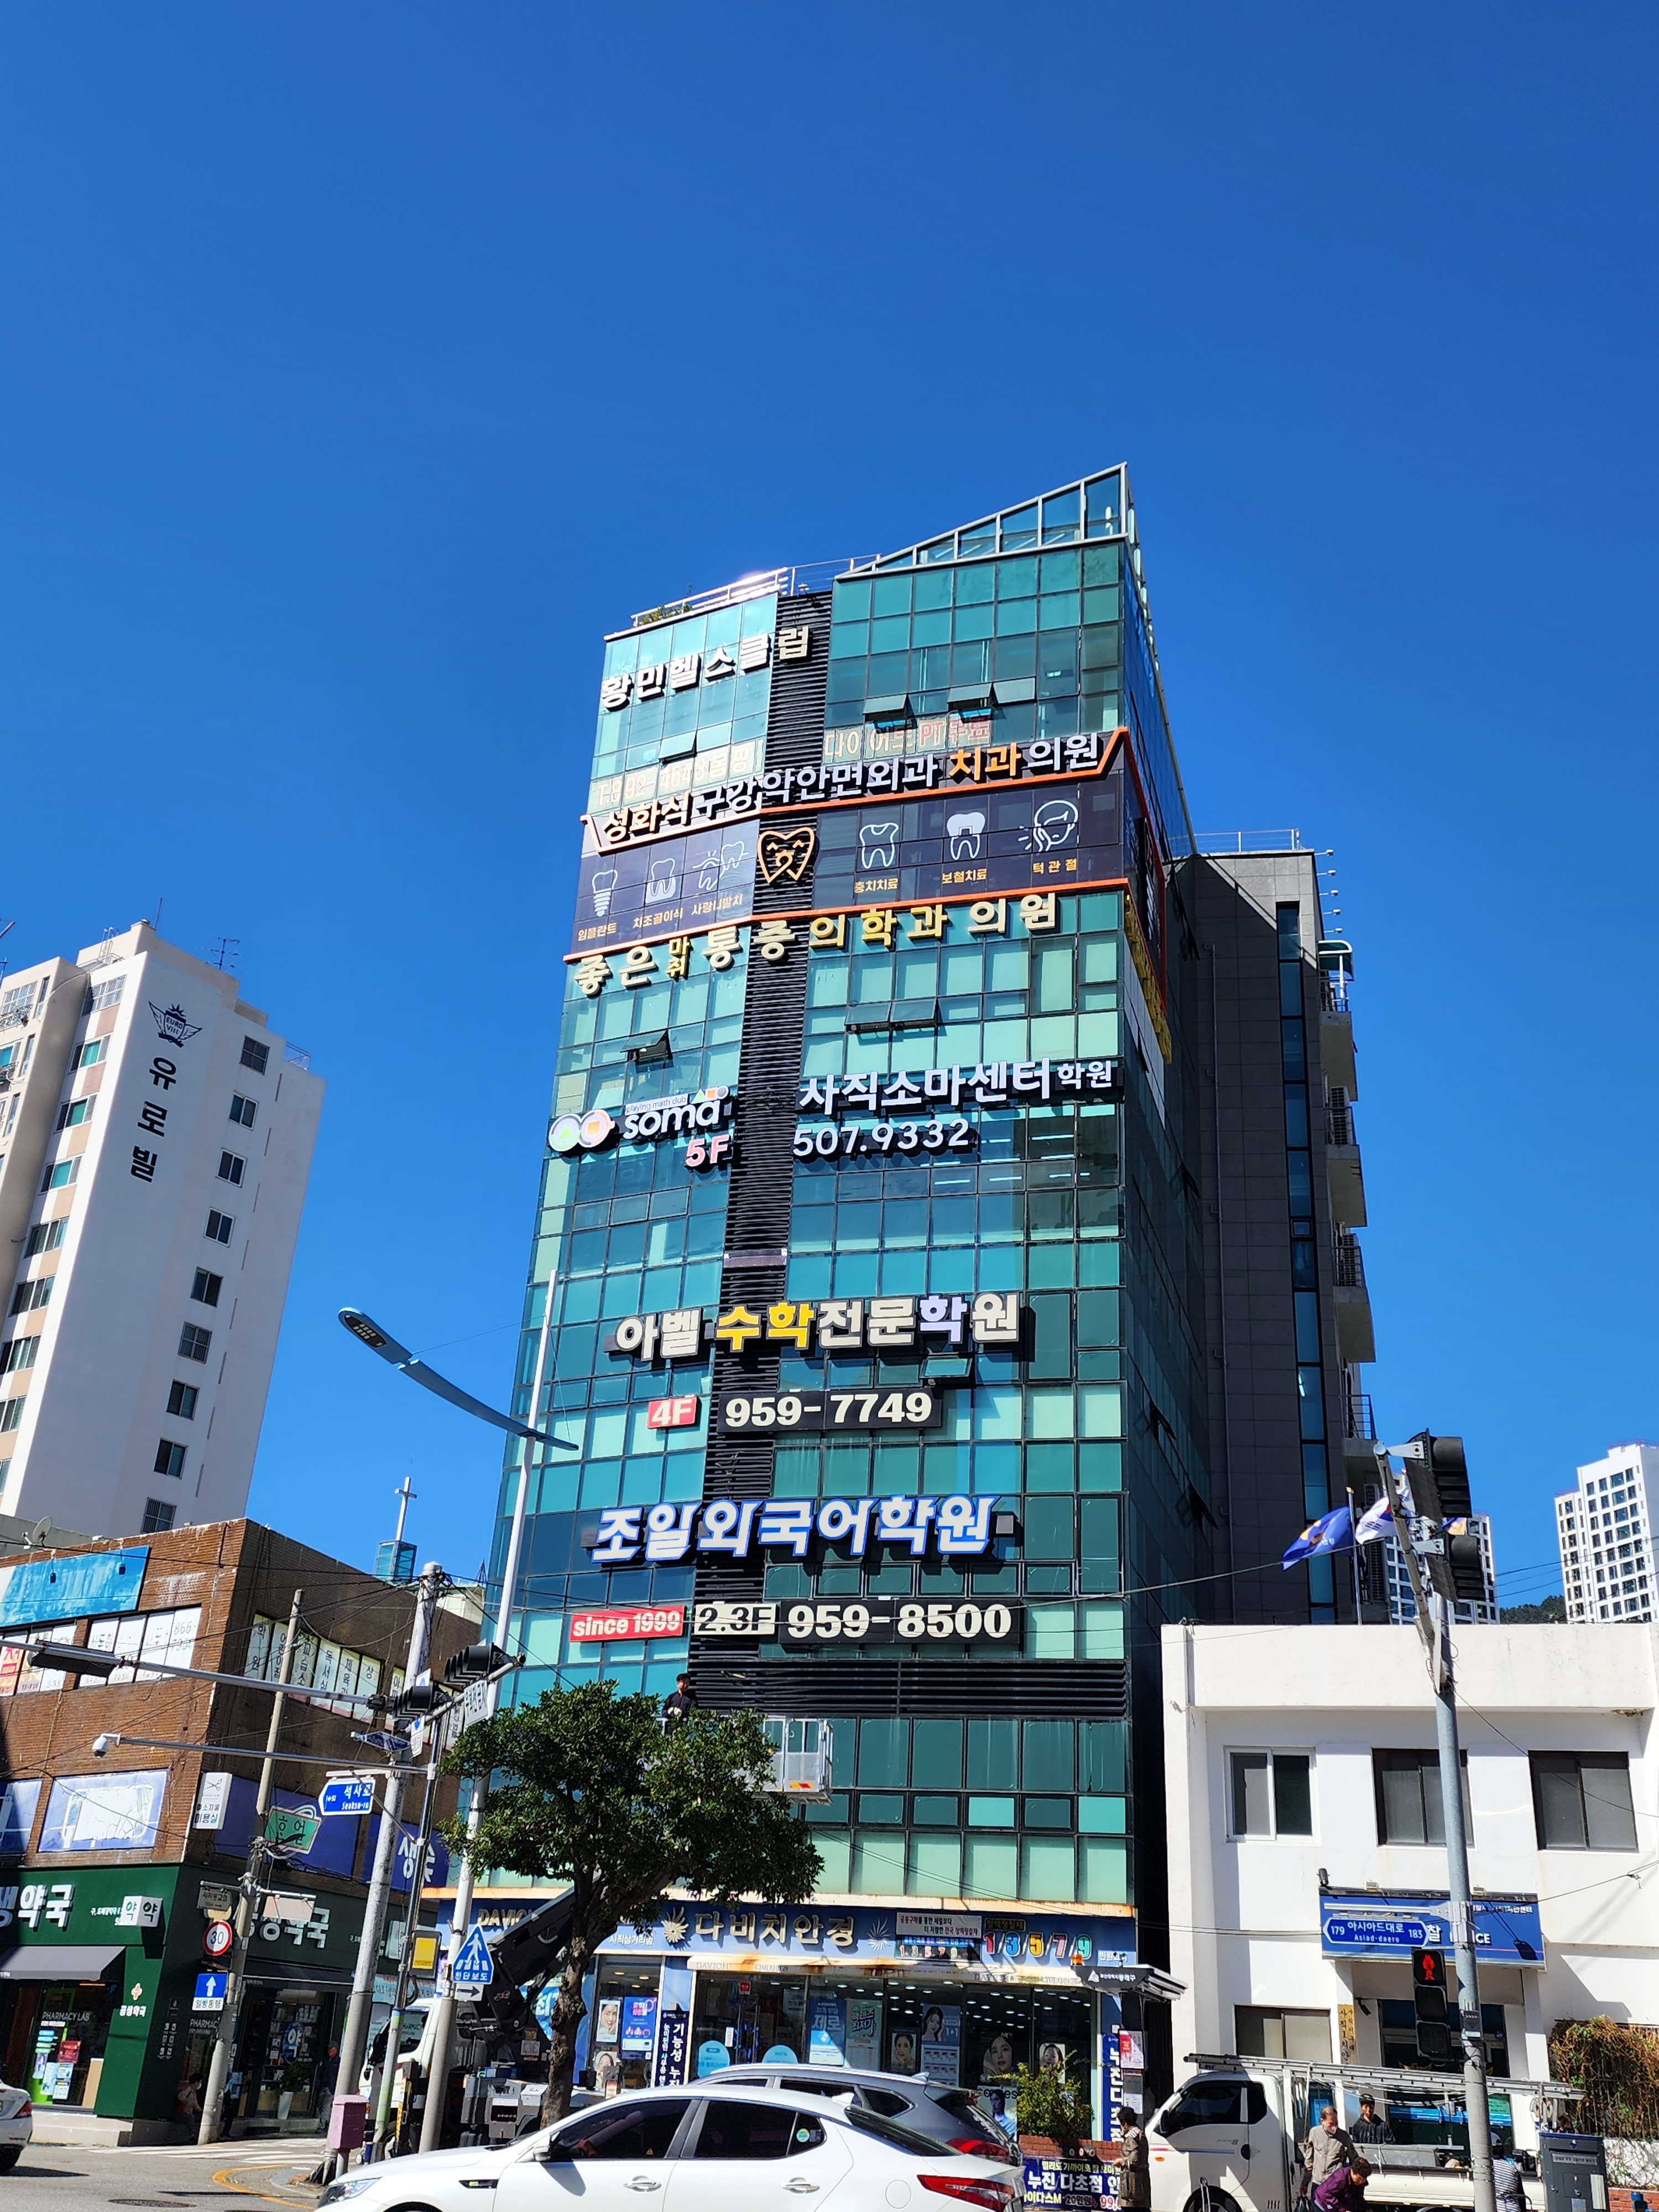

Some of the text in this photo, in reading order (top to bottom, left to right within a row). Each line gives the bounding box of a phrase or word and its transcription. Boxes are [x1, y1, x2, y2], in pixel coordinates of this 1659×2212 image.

[601, 625, 809, 708] 황민헬스클럽
[920, 721, 943, 747] PT
[854, 878, 898, 894] 충치치료
[942, 869, 988, 884] 보철치료
[691, 894, 743, 916] 사랑니발치
[633, 908, 683, 929] 치조골이식
[578, 922, 617, 941] 임플란트
[166, 1016, 183, 1030] EURO
[799, 1057, 1112, 1115] 사직소마센터 학원
[626, 1095, 687, 1114] playing math club
[623, 1100, 721, 1139] soma
[793, 1118, 969, 1156] 507.9332
[686, 1134, 729, 1167] 5F
[615, 1308, 702, 1361] 아벨
[652, 1399, 692, 1426] 4F
[725, 1391, 932, 1427] 959-7749
[592, 1495, 1000, 1563] 조일외국어학원
[573, 1610, 681, 1637] since 1999
[787, 1603, 1011, 1639] 959-8500
[194, 1813, 218, 1824] 미용실
[210, 1931, 224, 1944] 30
[695, 1911, 854, 1947] 다비치안경
[1331, 1922, 1423, 1939] 179 아시아드대로 183
[1354, 1933, 1400, 1943] Asiad-daero
[455, 1971, 488, 1981] 횡단보도
[696, 1962, 729, 1970] DAVICH
[42, 2011, 90, 2021] PHARMACY LAB
[190, 2018, 220, 2028] PHARMAC
[811, 2014, 842, 2031] 제로
[670, 2023, 685, 2062] 기능성
[946, 2027, 958, 2037] 1+1
[1042, 2161, 1063, 2171] 멀리도
[1027, 2171, 1056, 2190] 누진
[1060, 2173, 1103, 2194] 다초점
